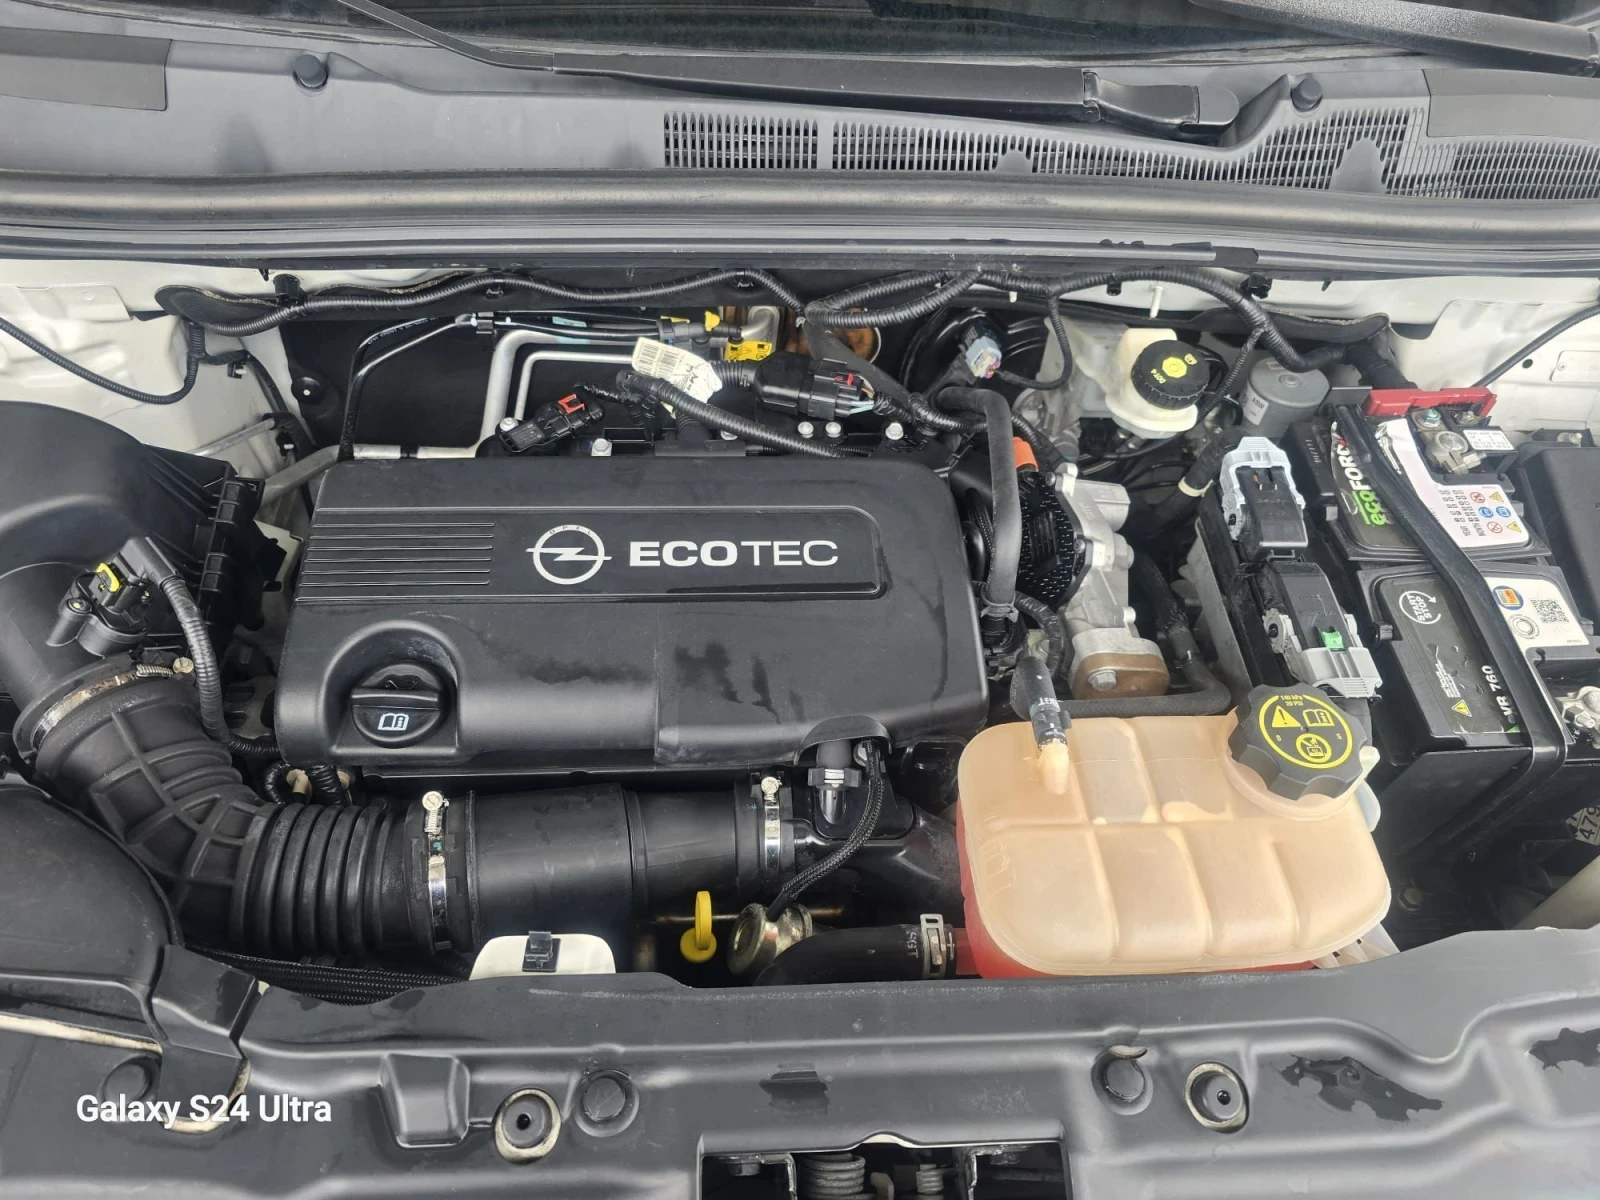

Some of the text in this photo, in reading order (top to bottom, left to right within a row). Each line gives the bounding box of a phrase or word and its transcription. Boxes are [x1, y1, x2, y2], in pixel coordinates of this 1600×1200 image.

[548, 525, 592, 535] OPEL
[629, 540, 838, 567] ECOTEC
[1406, 594, 1425, 622] START
[1414, 595, 1433, 619] STOP
[1481, 665, 1513, 716] VR 760
